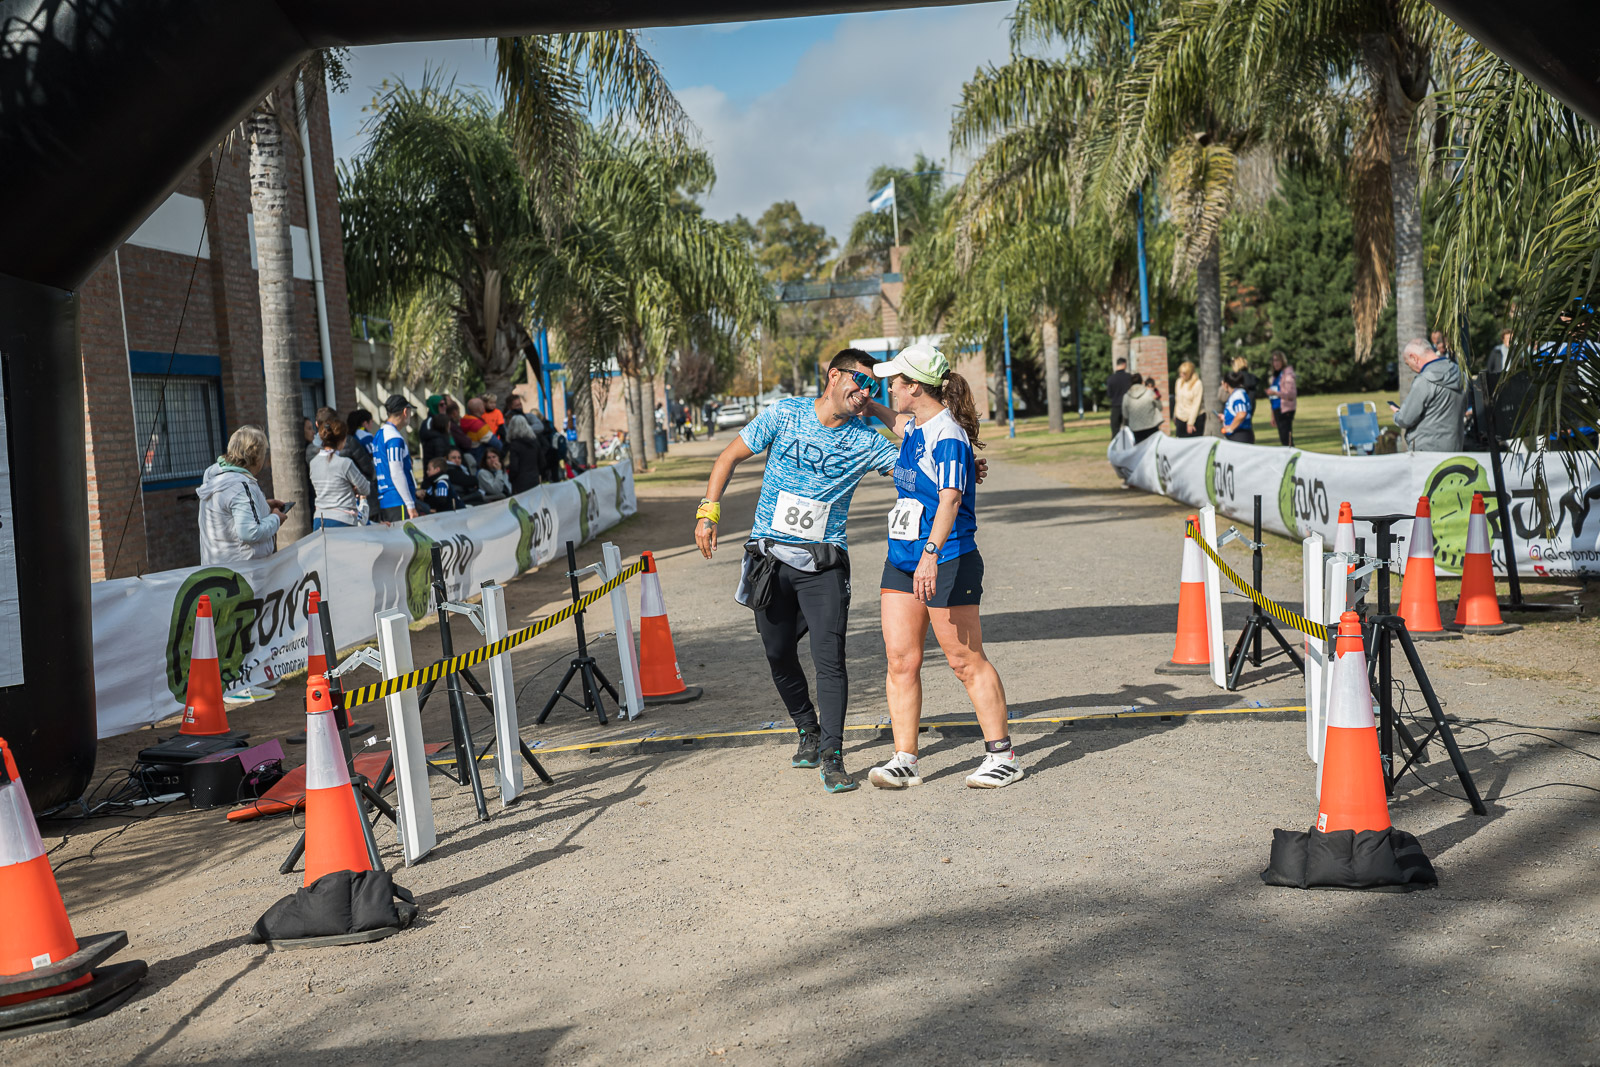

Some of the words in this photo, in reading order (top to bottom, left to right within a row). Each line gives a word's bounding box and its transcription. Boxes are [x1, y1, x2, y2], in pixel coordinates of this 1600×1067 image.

[780, 438, 848, 479] ARG
[785, 506, 814, 530] 86
[891, 509, 911, 530] 74
